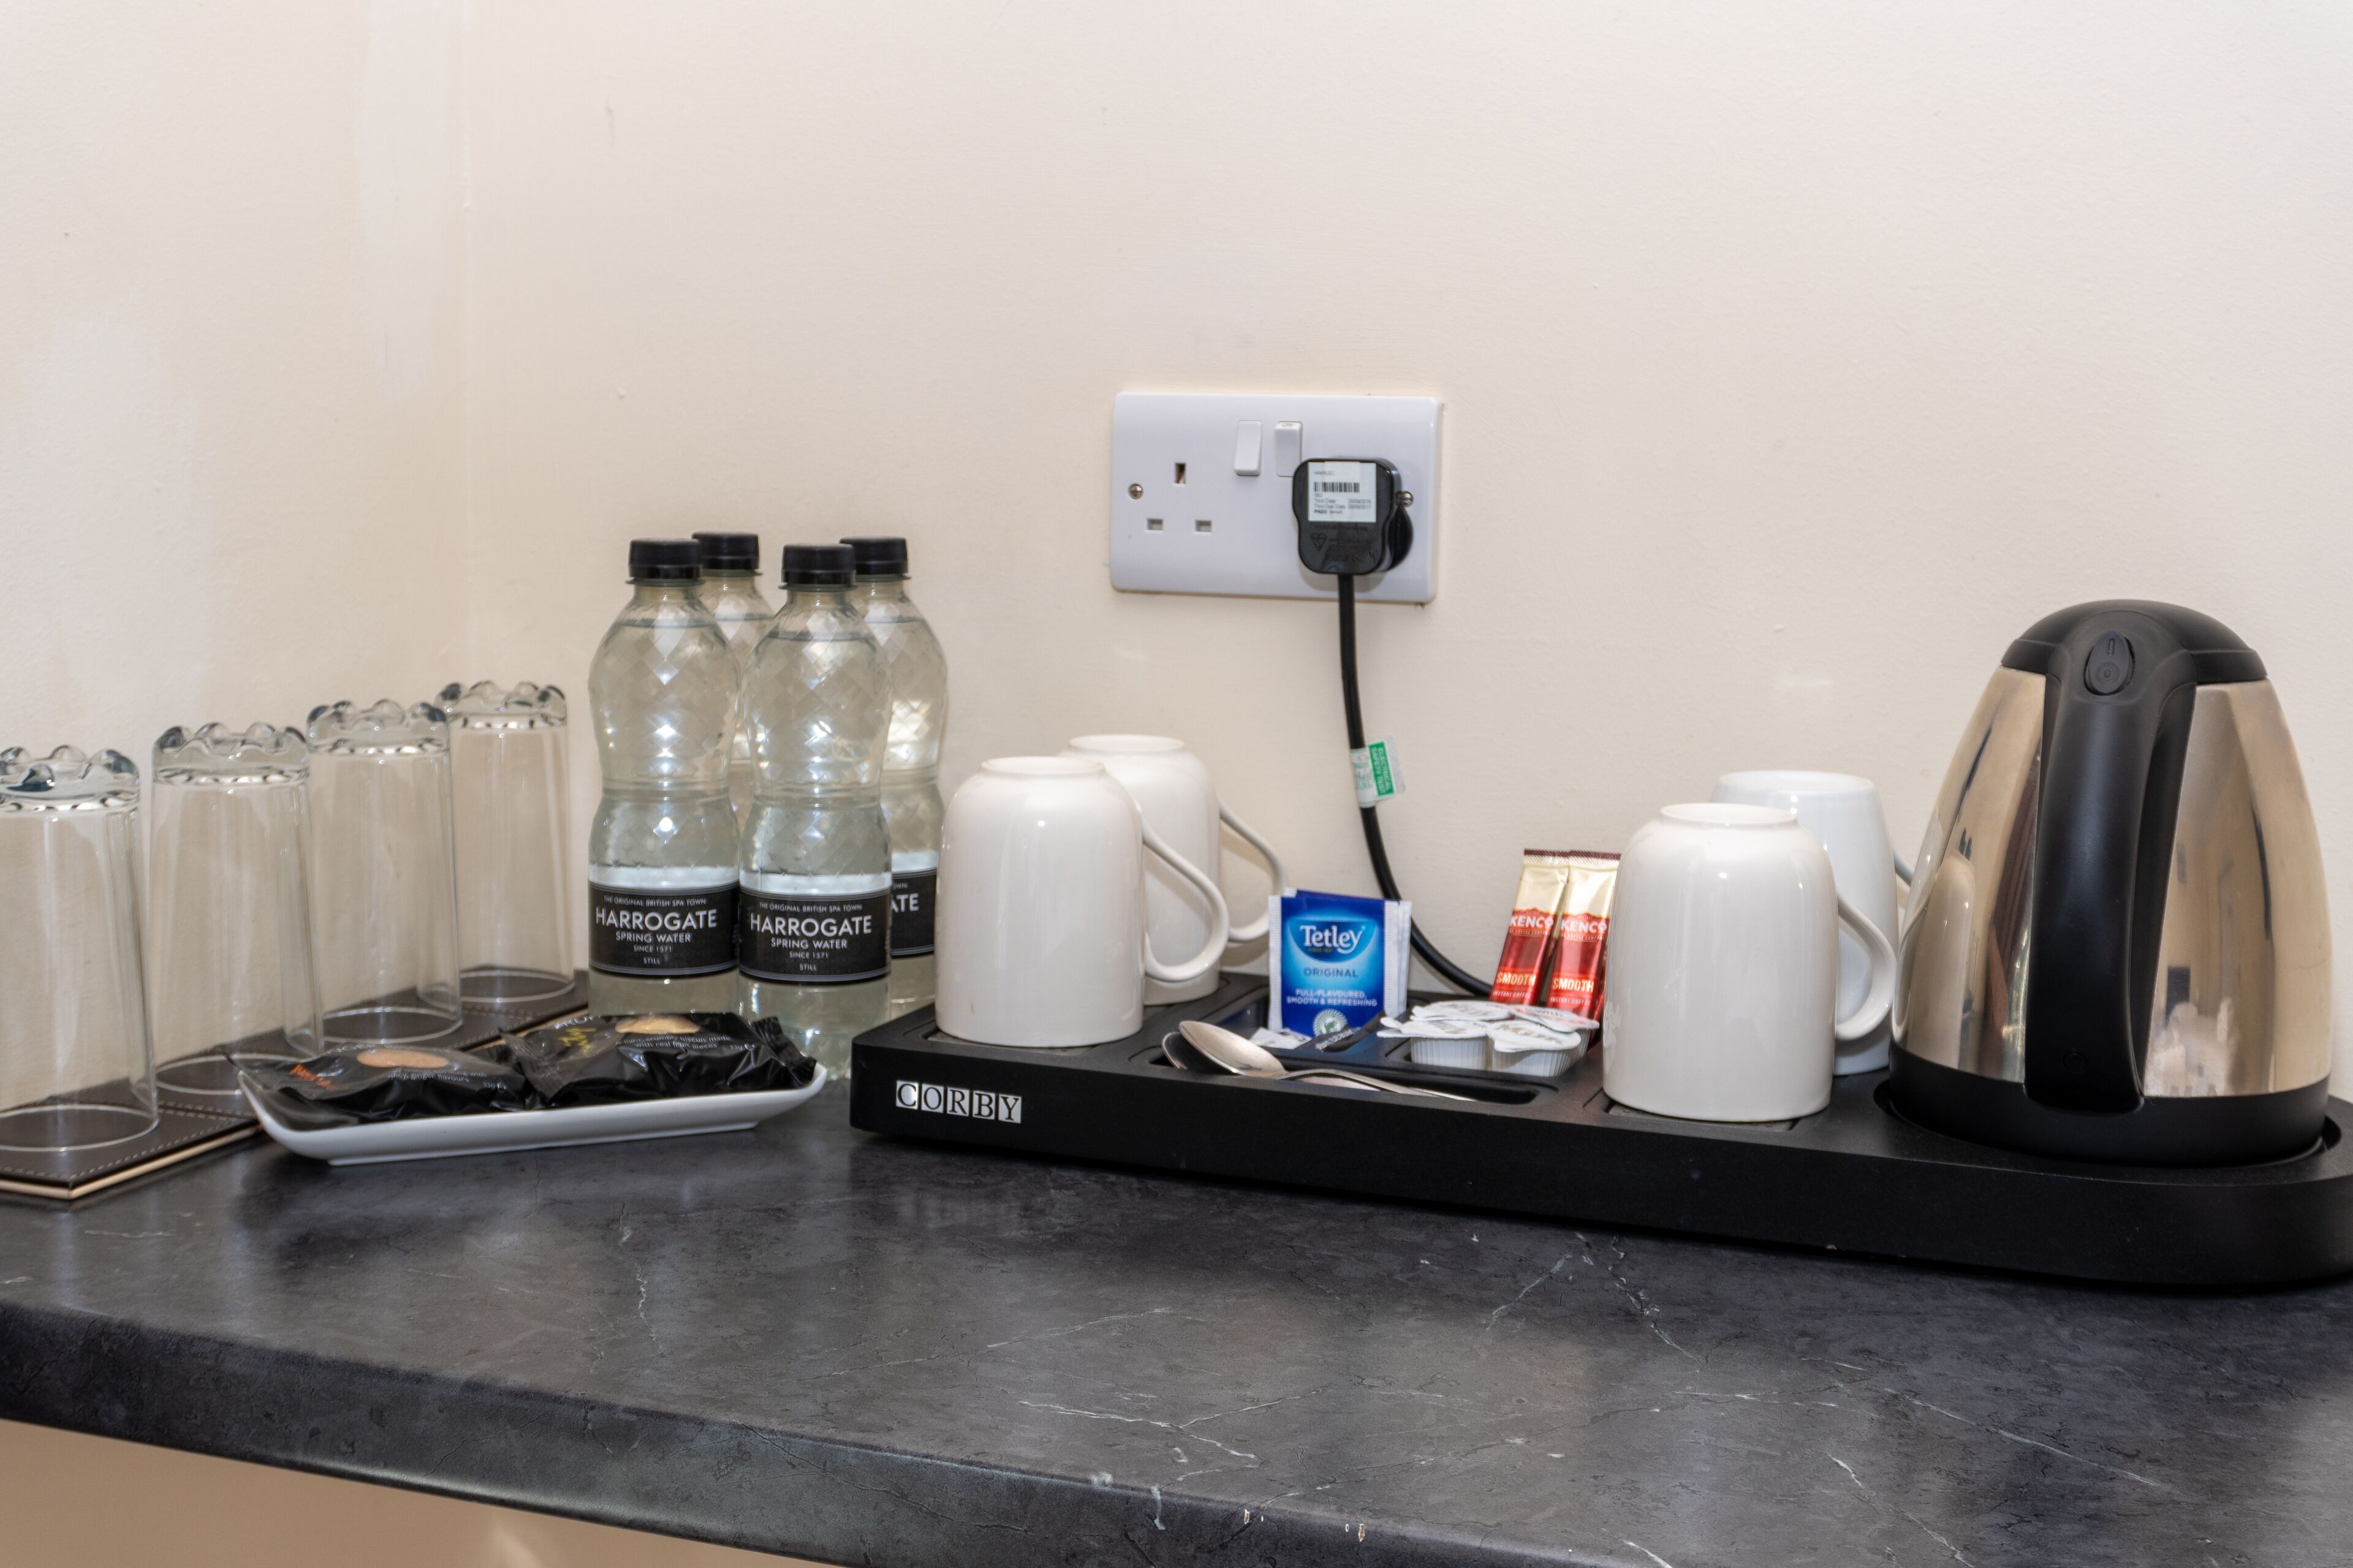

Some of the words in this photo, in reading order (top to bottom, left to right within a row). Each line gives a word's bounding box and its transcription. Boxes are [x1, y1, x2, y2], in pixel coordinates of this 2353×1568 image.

[614, 897, 643, 906] ORIGINAL
[686, 898, 707, 906] TOWN
[770, 903, 800, 912] ORIGINAL
[843, 904, 863, 912] TOWN
[596, 906, 718, 931] HARROGATE
[751, 912, 872, 937] HARROGATE
[1510, 915, 1555, 928] KENCO
[1561, 919, 1607, 933] KENCO
[616, 931, 652, 943] SPRING
[656, 932, 692, 943] WATER
[771, 937, 808, 949] SPRING
[813, 939, 847, 949] WATER
[1300, 925, 1363, 954] Tetley
[634, 944, 653, 953] SINCE
[1303, 968, 1359, 978] ORIGINAL
[1497, 972, 1536, 986] SMOOTH
[1553, 977, 1594, 992] SMOOTH
[1286, 996, 1319, 1004] SMOOTH
[1327, 998, 1377, 1007] REFRESHING
[438, 1074, 469, 1083] flavours
[896, 1082, 1020, 1122] CORBY
